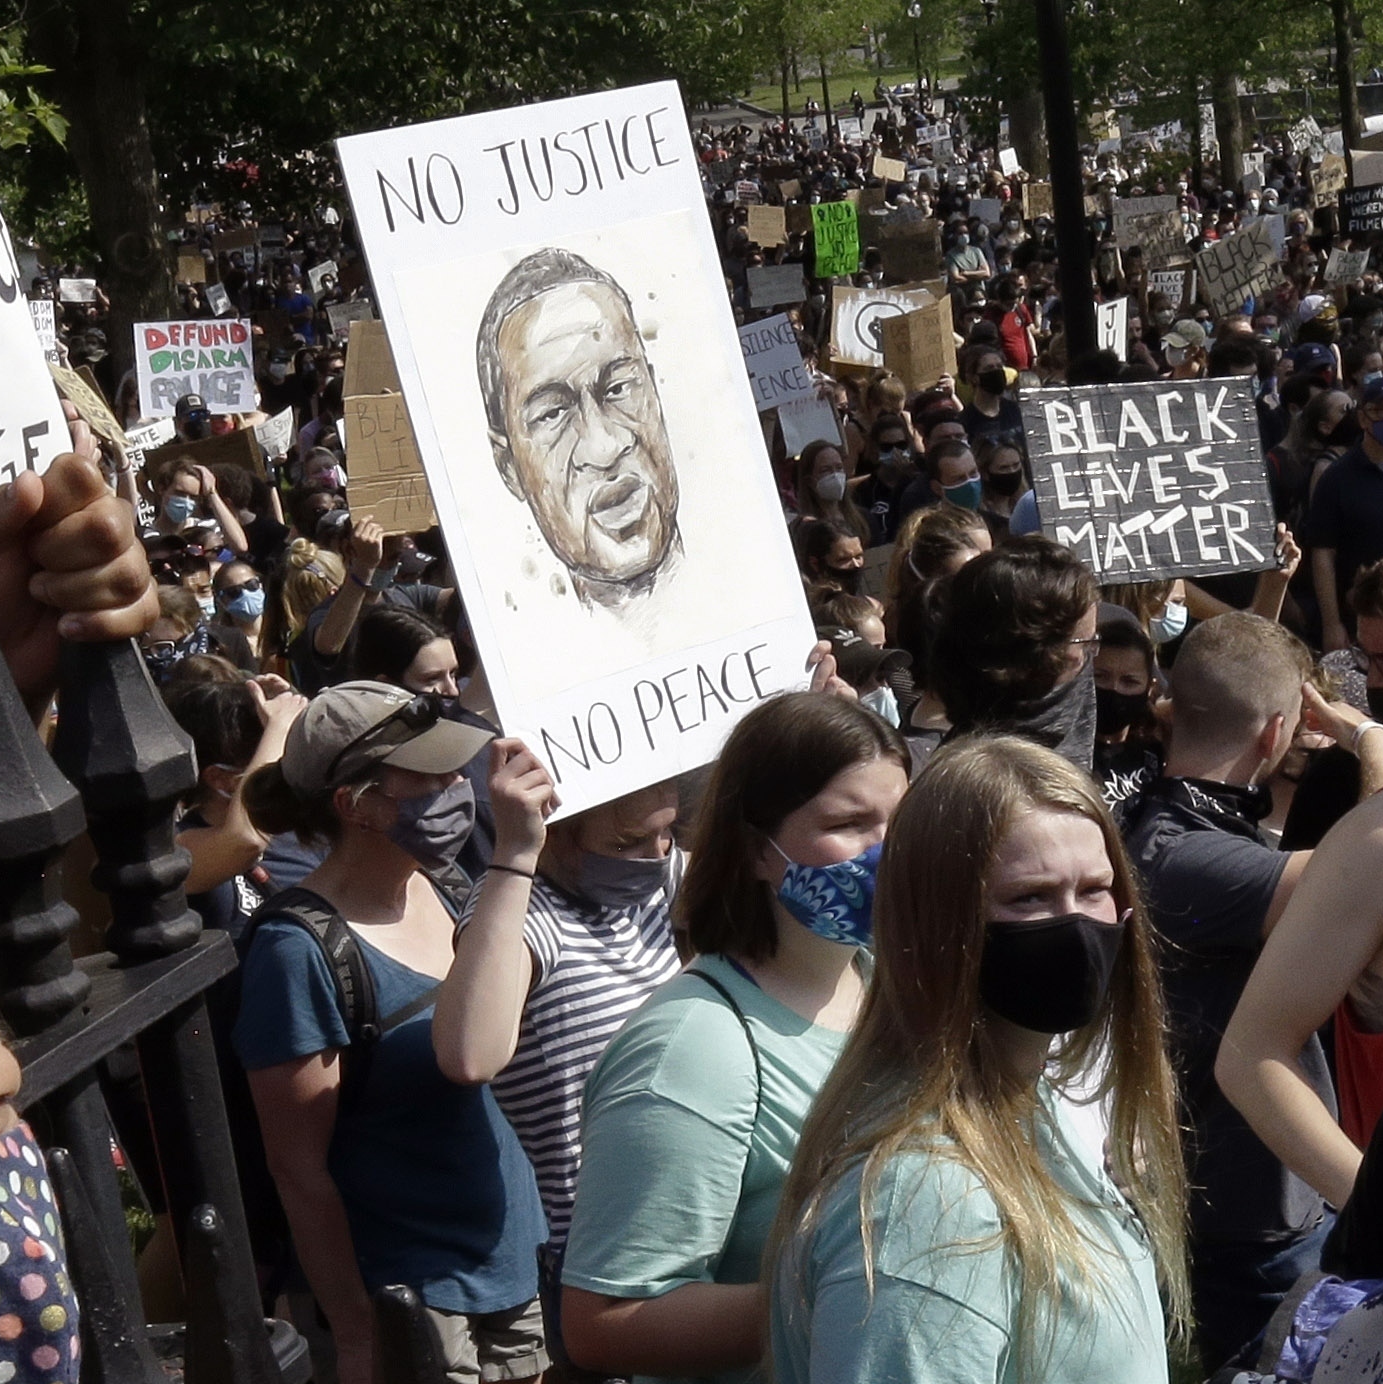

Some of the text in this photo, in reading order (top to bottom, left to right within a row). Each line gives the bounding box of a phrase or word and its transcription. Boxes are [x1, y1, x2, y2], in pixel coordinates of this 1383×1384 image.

[376, 107, 680, 233] NO JUSTICE
[828, 204, 845, 222] NO
[1199, 229, 1272, 285] BLACK
[145, 322, 248, 351] DEFUND
[148, 349, 250, 375] DISARM
[757, 366, 808, 401] ENCE
[356, 402, 407, 440] BLA
[1044, 386, 1238, 456] BLACK
[1055, 504, 1265, 573] MATTER
[536, 642, 785, 785] NO PEACE
